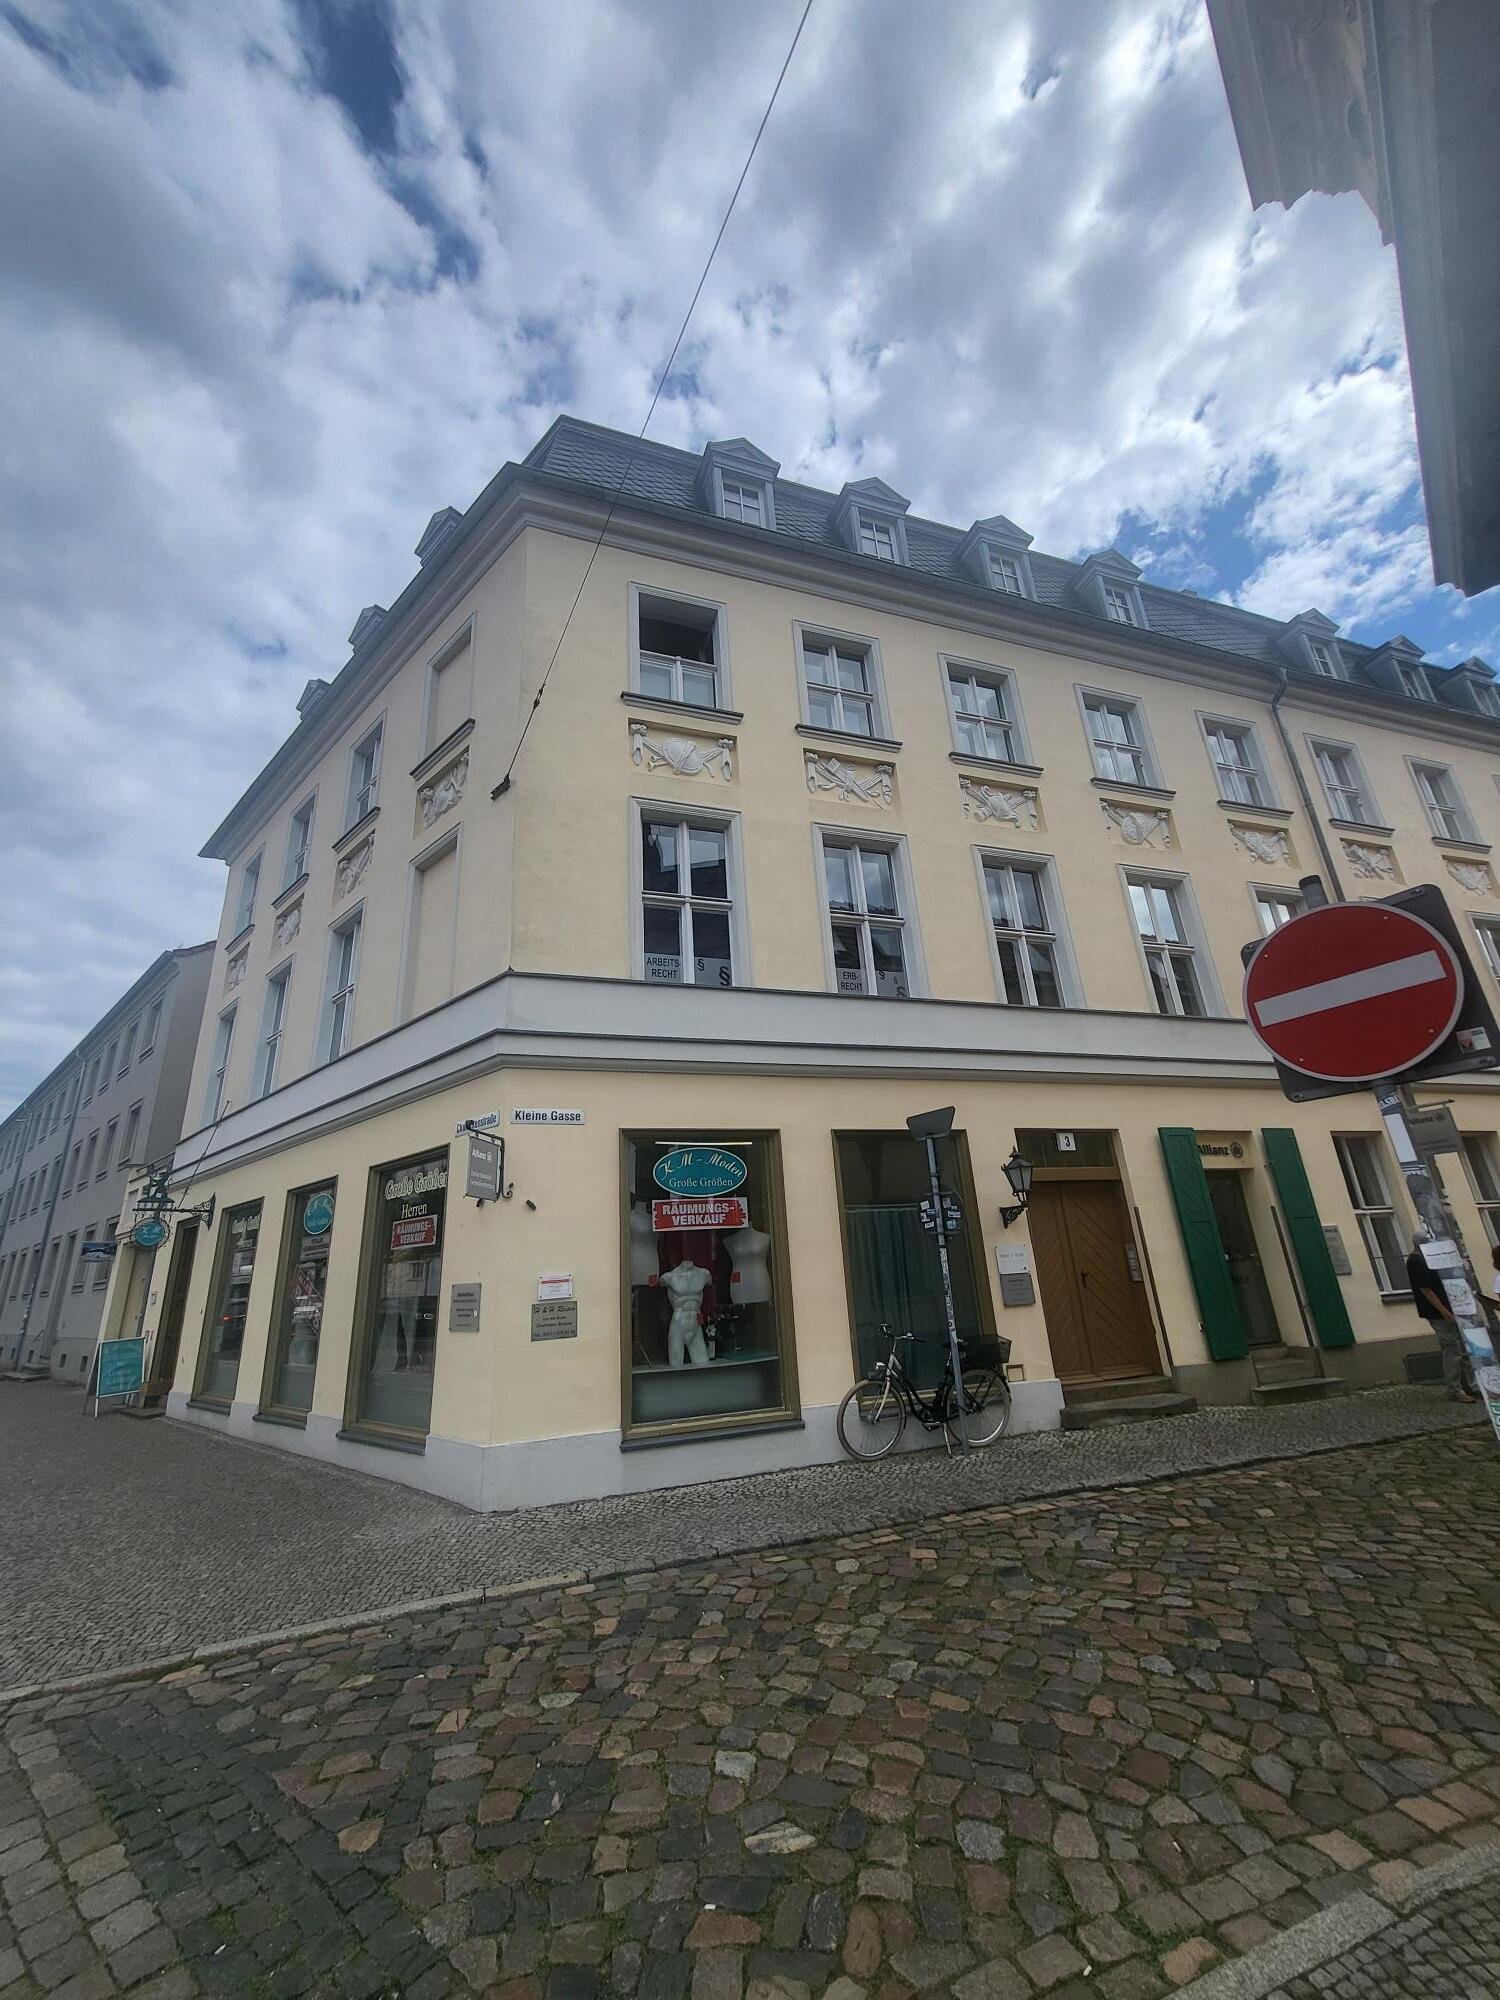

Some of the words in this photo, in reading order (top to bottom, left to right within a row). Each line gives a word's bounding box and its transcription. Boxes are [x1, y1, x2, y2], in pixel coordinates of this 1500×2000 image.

[651, 968, 678, 979] RECHT
[842, 971, 859, 980] ERB-
[840, 981, 862, 991] RECHT
[515, 1110, 548, 1121] Kleine
[550, 1110, 582, 1121] Gasse
[1065, 1135, 1071, 1147] 3
[704, 1153, 743, 1177] Moden
[668, 1177, 698, 1187] Große
[699, 1176, 733, 1187] Größen
[385, 1176, 413, 1200] Große
[401, 1203, 427, 1219] Herren
[662, 1202, 735, 1216] RÄUMUNGS-
[671, 1213, 726, 1226] VERKAUF
[400, 1231, 427, 1245] VERKAUF
